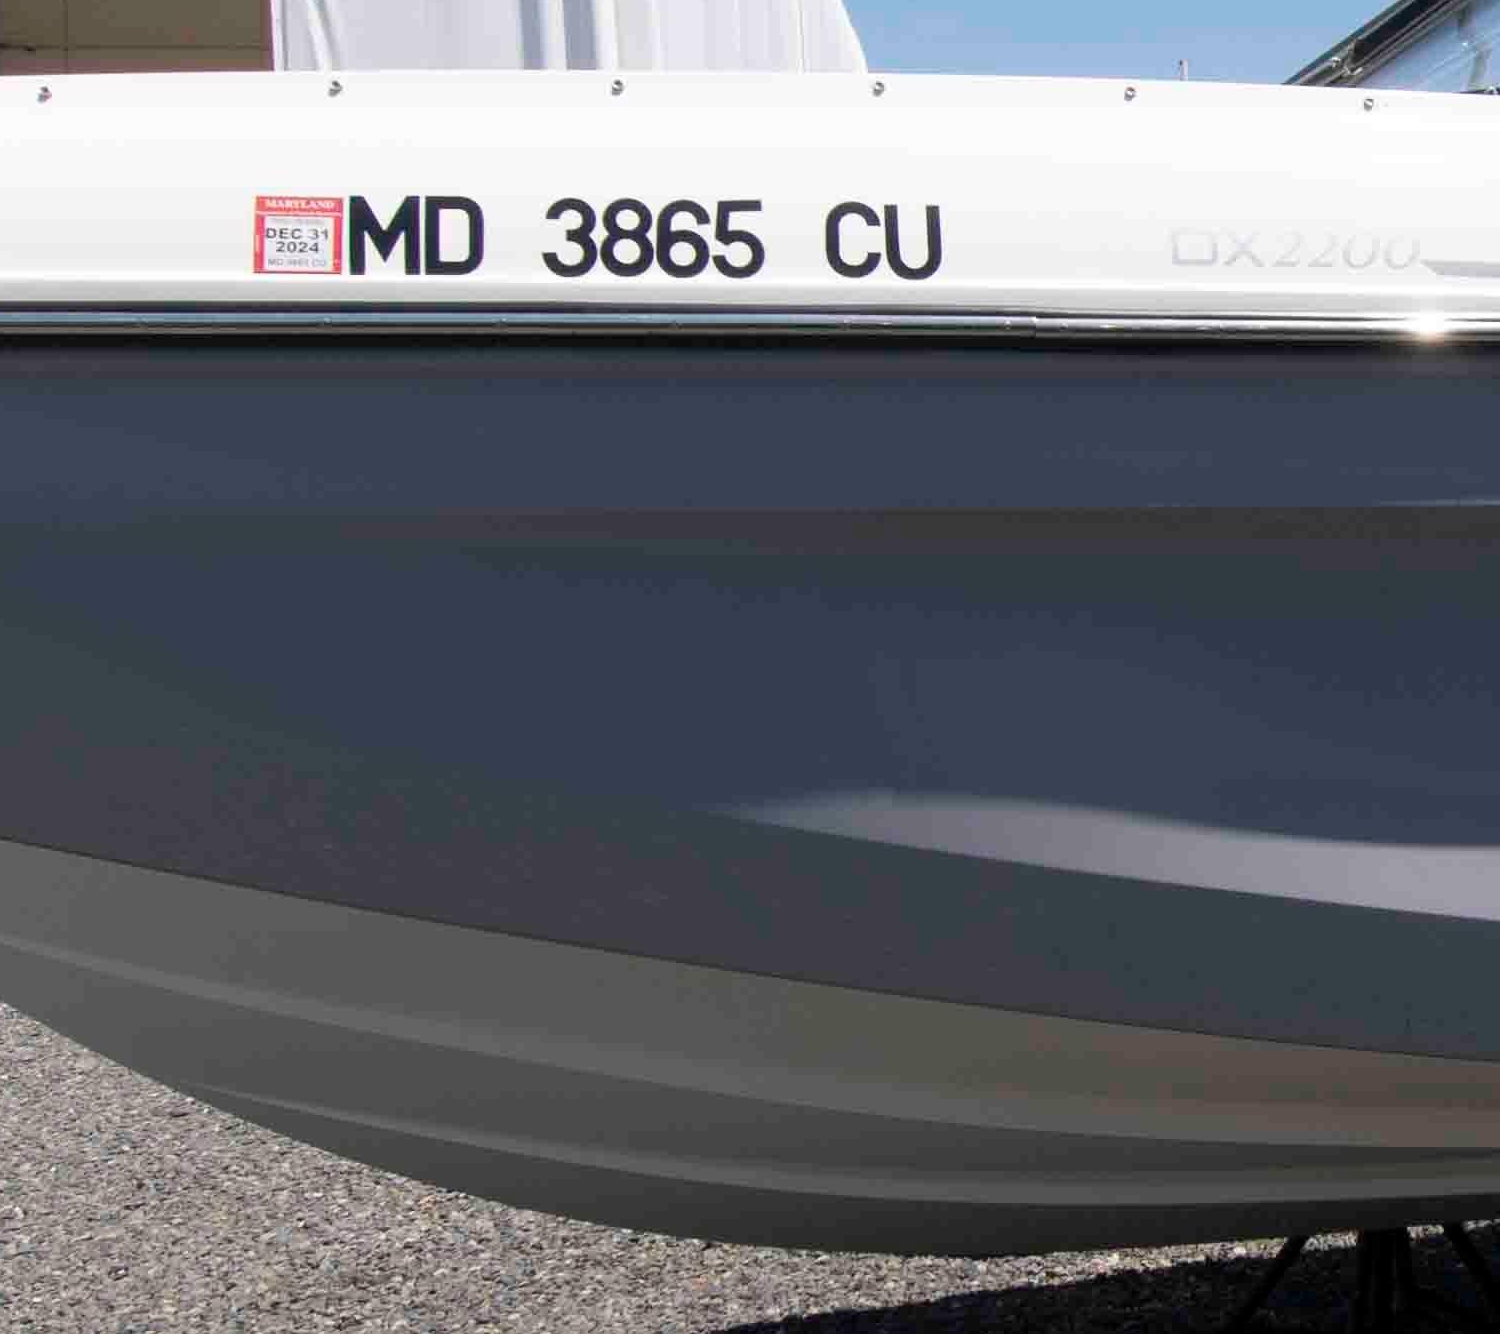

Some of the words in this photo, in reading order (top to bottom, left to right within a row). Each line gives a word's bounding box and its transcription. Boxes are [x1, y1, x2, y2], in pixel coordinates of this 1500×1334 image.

[266, 227, 302, 240] DEC
[307, 228, 328, 240] 31
[349, 195, 484, 275] MD
[542, 197, 765, 279] 3865
[825, 202, 943, 280] CU
[275, 241, 319, 254] 2024
